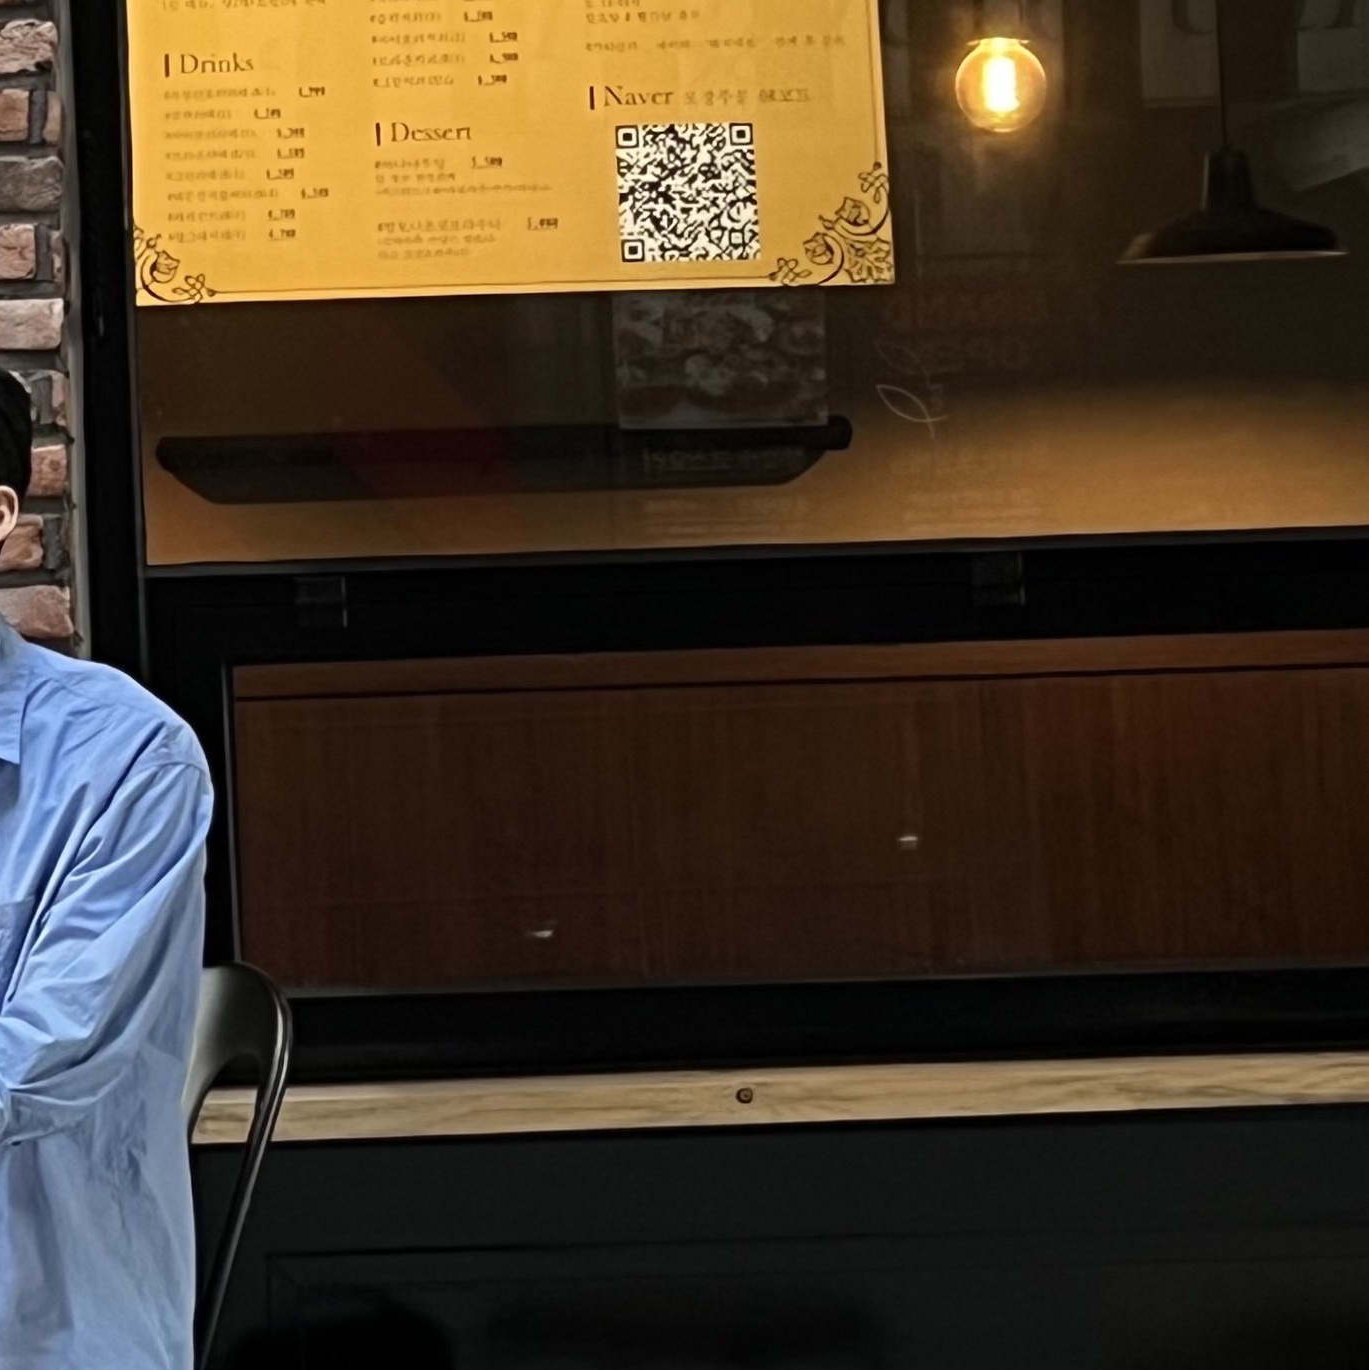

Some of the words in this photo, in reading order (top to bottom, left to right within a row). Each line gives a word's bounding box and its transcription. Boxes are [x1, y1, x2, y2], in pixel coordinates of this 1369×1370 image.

[180, 53, 254, 74] Drinks
[604, 85, 674, 107] Naver
[391, 122, 471, 142] Dessert
